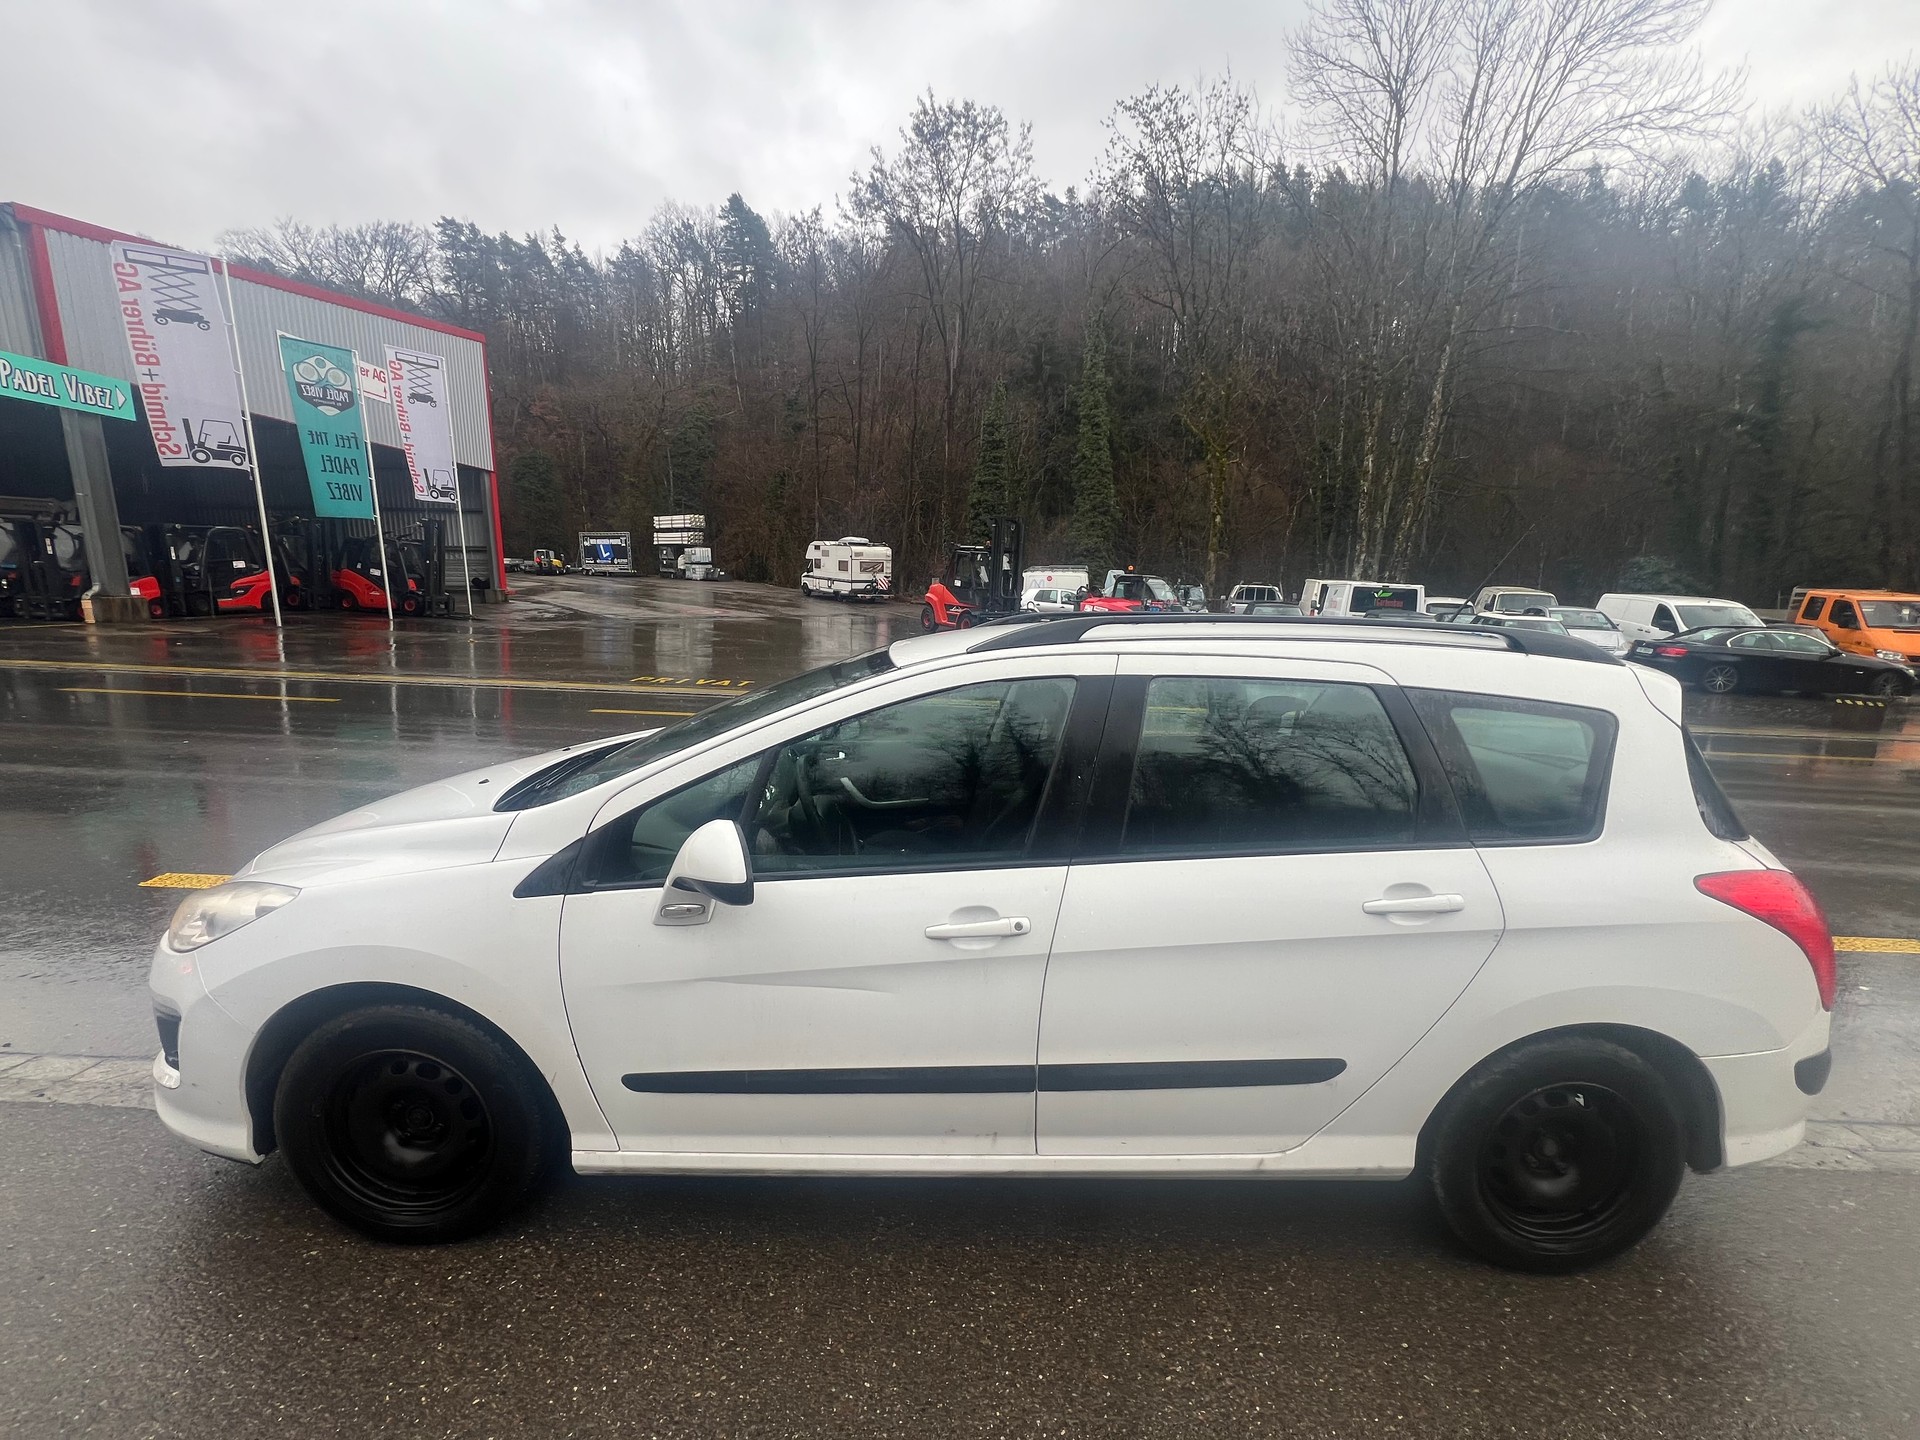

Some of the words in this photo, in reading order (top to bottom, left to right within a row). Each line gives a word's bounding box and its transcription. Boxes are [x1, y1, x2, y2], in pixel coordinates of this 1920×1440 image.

[373, 368, 387, 384] AG
[61, 372, 115, 410] VIBEZ
[630, 676, 755, 687] PRIVAT
